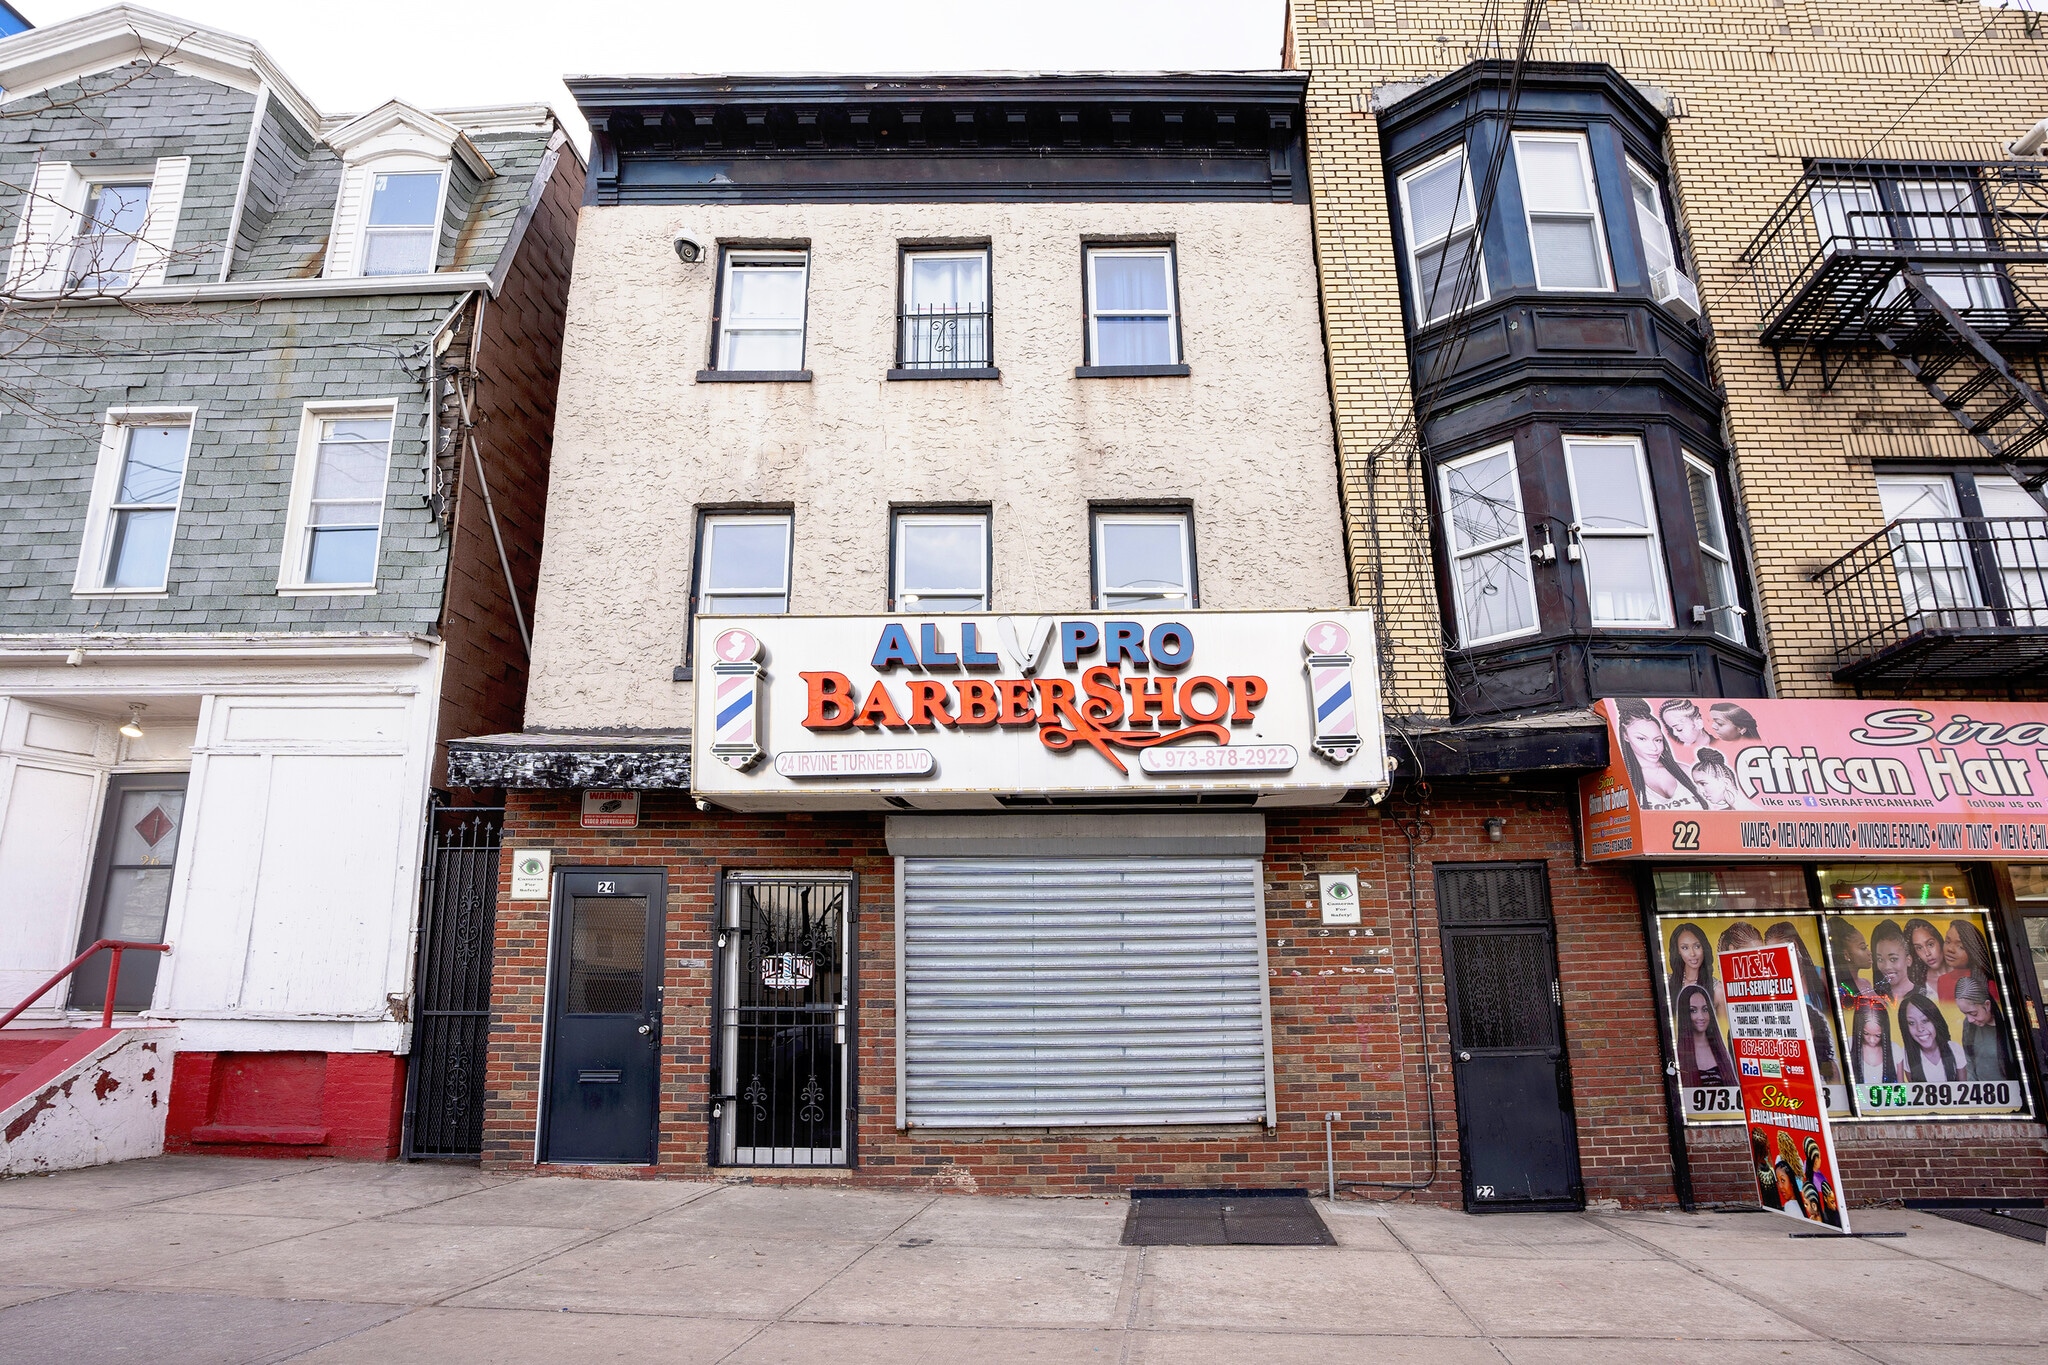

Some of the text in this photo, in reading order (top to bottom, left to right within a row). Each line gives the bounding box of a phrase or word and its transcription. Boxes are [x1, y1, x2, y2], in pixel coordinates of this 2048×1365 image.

[871, 621, 1195, 669] ALL PRO
[799, 666, 1269, 734] BARBERSHOP
[1850, 708, 2048, 746] Sira
[781, 752, 929, 772] 24 IRVINE TURNER BLVD
[1165, 748, 1290, 768] 973-878-2922
[1735, 746, 1916, 799] African
[1917, 748, 2035, 801] Hair
[589, 791, 634, 800] WARNING
[1761, 797, 1934, 808] like us SIRAAFRICANHAIR
[1967, 799, 2005, 808] follow
[1672, 821, 1700, 851] 22
[1740, 821, 1770, 849] WAVES
[1778, 822, 1797, 849] MEN
[1799, 822, 1823, 849] CORN
[1824, 822, 1850, 849] ROWS
[1858, 822, 1898, 849] INVISIBLE
[1899, 822, 1930, 849] BRAIDS
[1937, 823, 1962, 849] KINKY
[1965, 823, 1993, 850] TWIST
[2000, 824, 2020, 850] MEN
[2022, 824, 2029, 850] &
[598, 882, 615, 893] 24
[1732, 952, 1778, 980] M&K
[1726, 978, 1794, 998] MULTI-SERVICE LLC
[1735, 1002, 1793, 1013] INTERNATIONAL MONEY TRANSFER
[1737, 1016, 1759, 1025] TRAVEL AGENT
[1746, 1028, 1762, 1037] PRINTING
[1764, 1028, 1773, 1037] COPY
[1787, 1028, 1798, 1037] MORE
[1741, 1039, 1800, 1058] 862-588-0863
[1742, 1060, 1760, 1076] Ria
[1760, 1085, 1804, 1109] Sira
[1870, 1083, 2010, 1107] 973.289.2480
[1750, 1108, 1820, 1133] AFRICAN HAIR BRAIDING
[1477, 1186, 1494, 1198] 22
